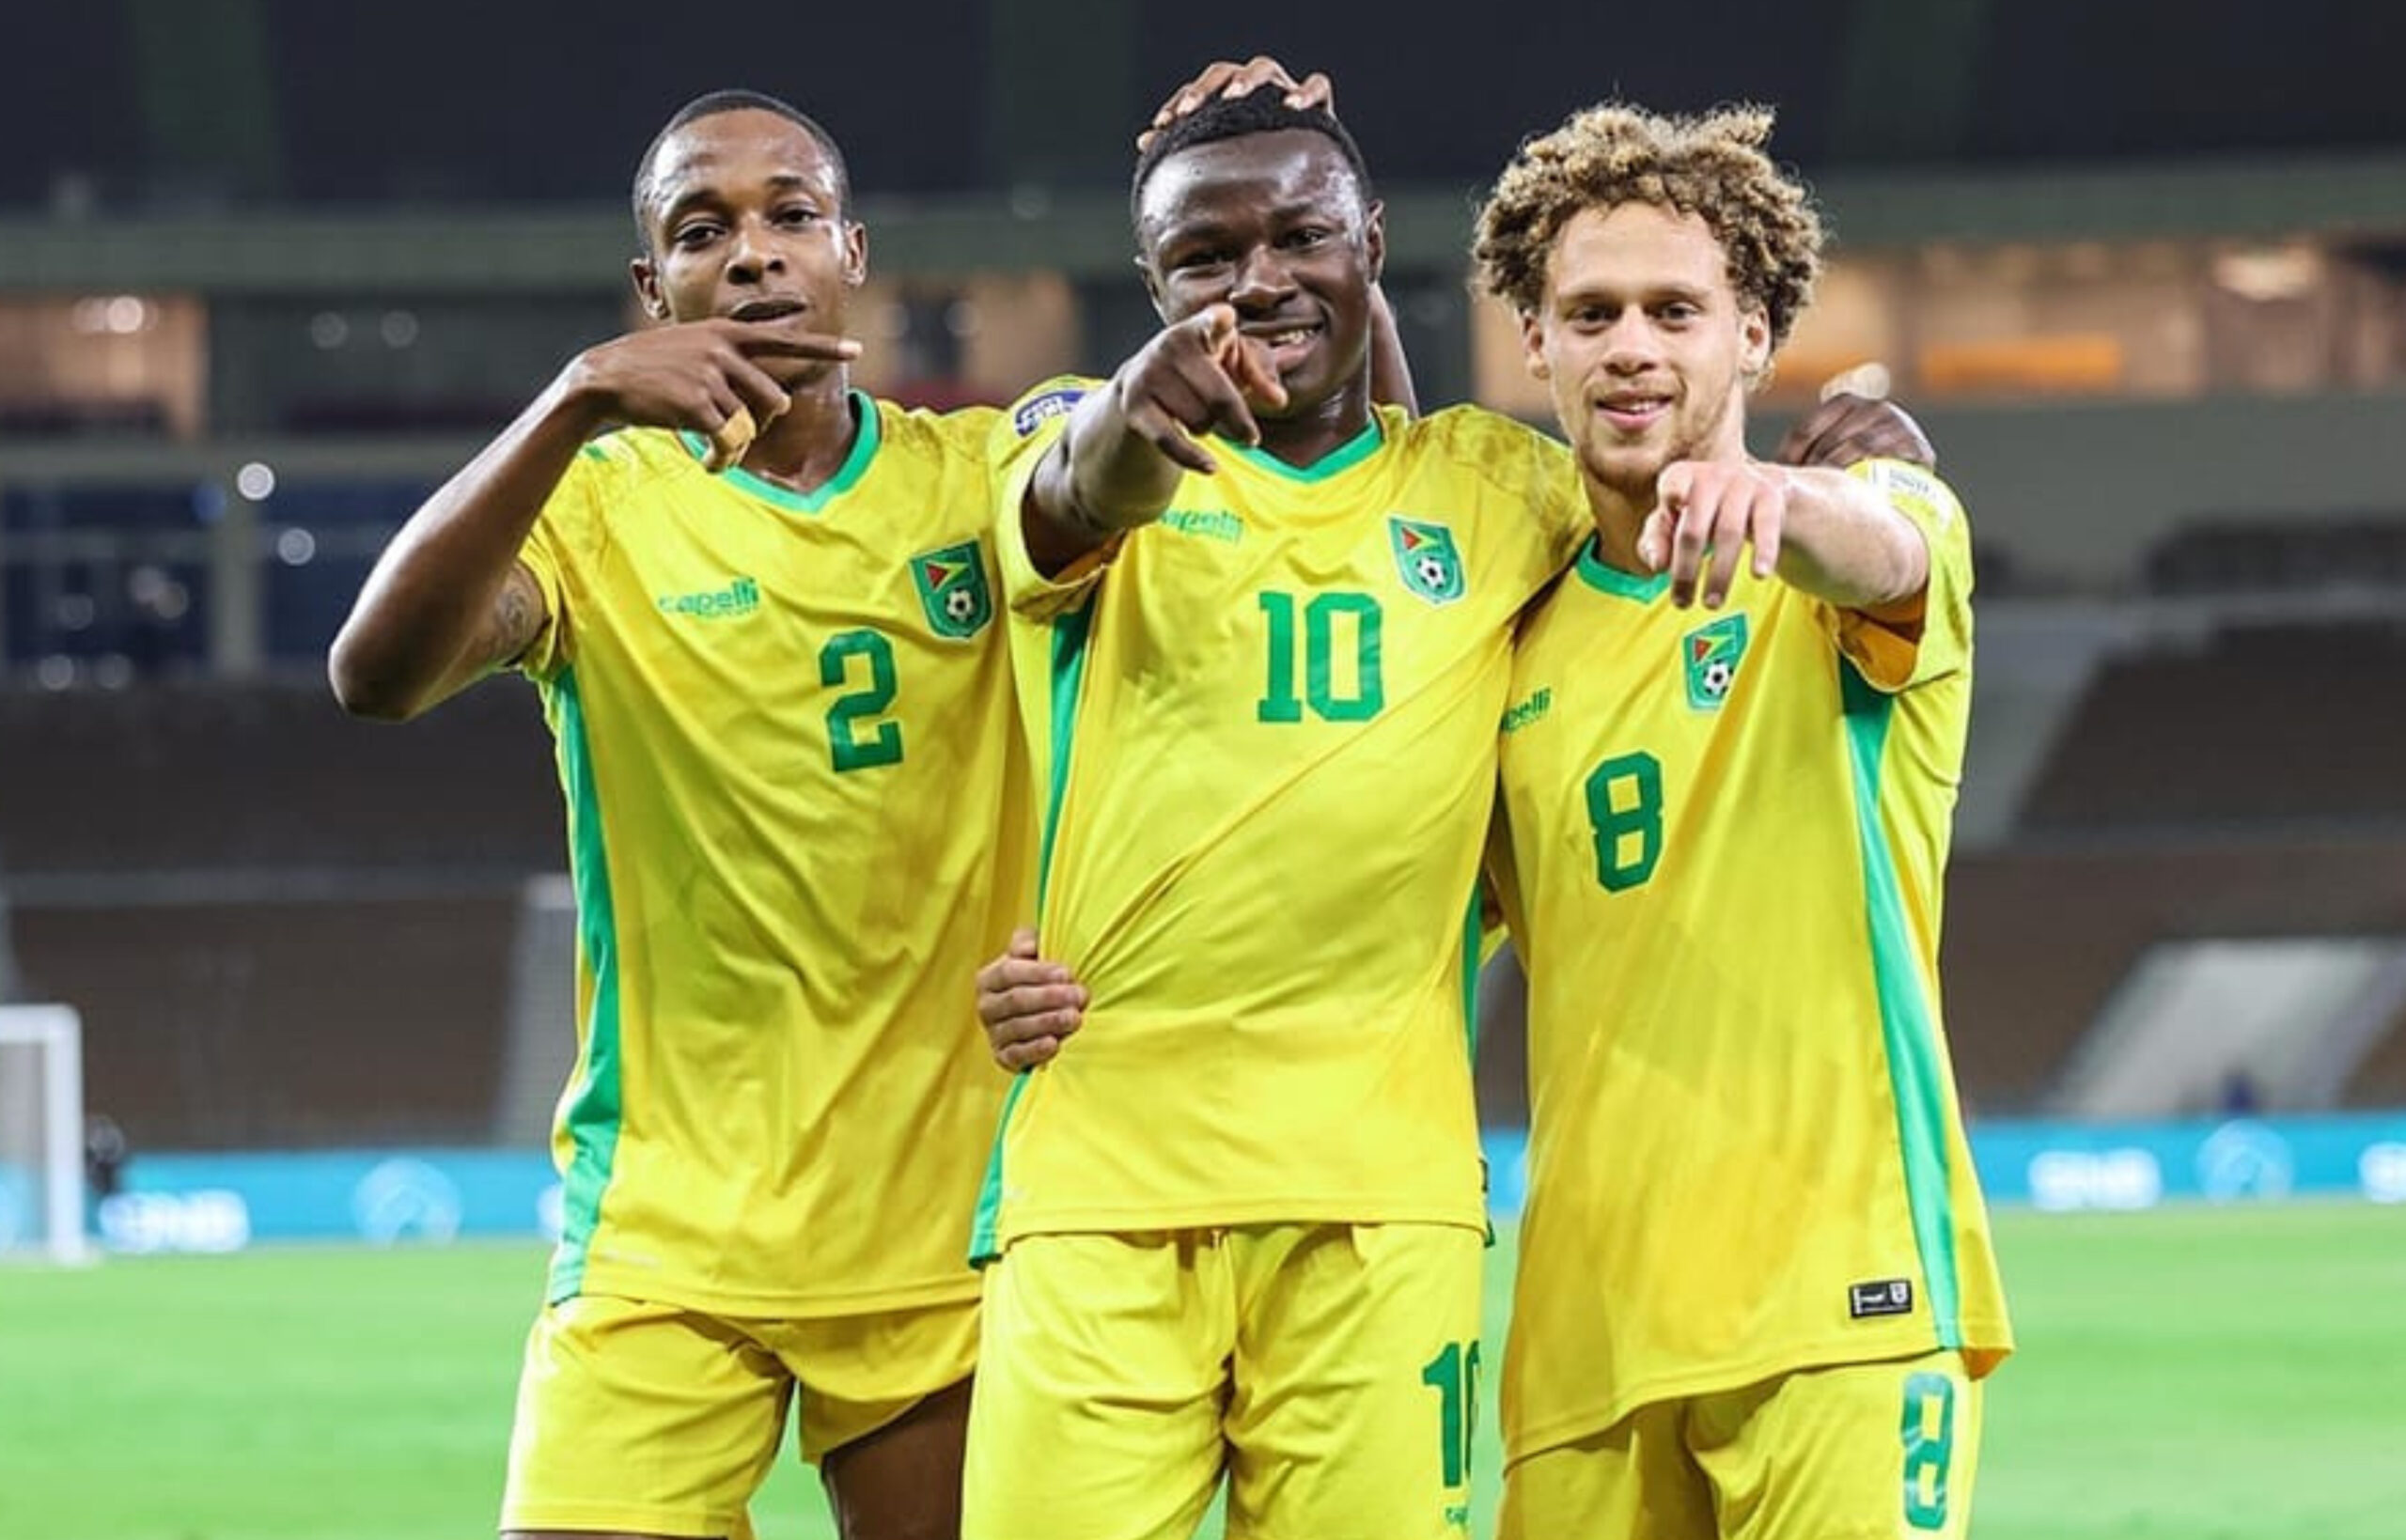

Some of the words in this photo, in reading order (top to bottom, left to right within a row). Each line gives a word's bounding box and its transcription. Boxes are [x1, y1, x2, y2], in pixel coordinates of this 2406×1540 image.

[658, 576, 758, 616] capelli
[1258, 591, 1384, 723] 10
[820, 630, 903, 772] 2
[1586, 751, 1663, 893] 8
[1901, 1373, 1954, 1530] 8
